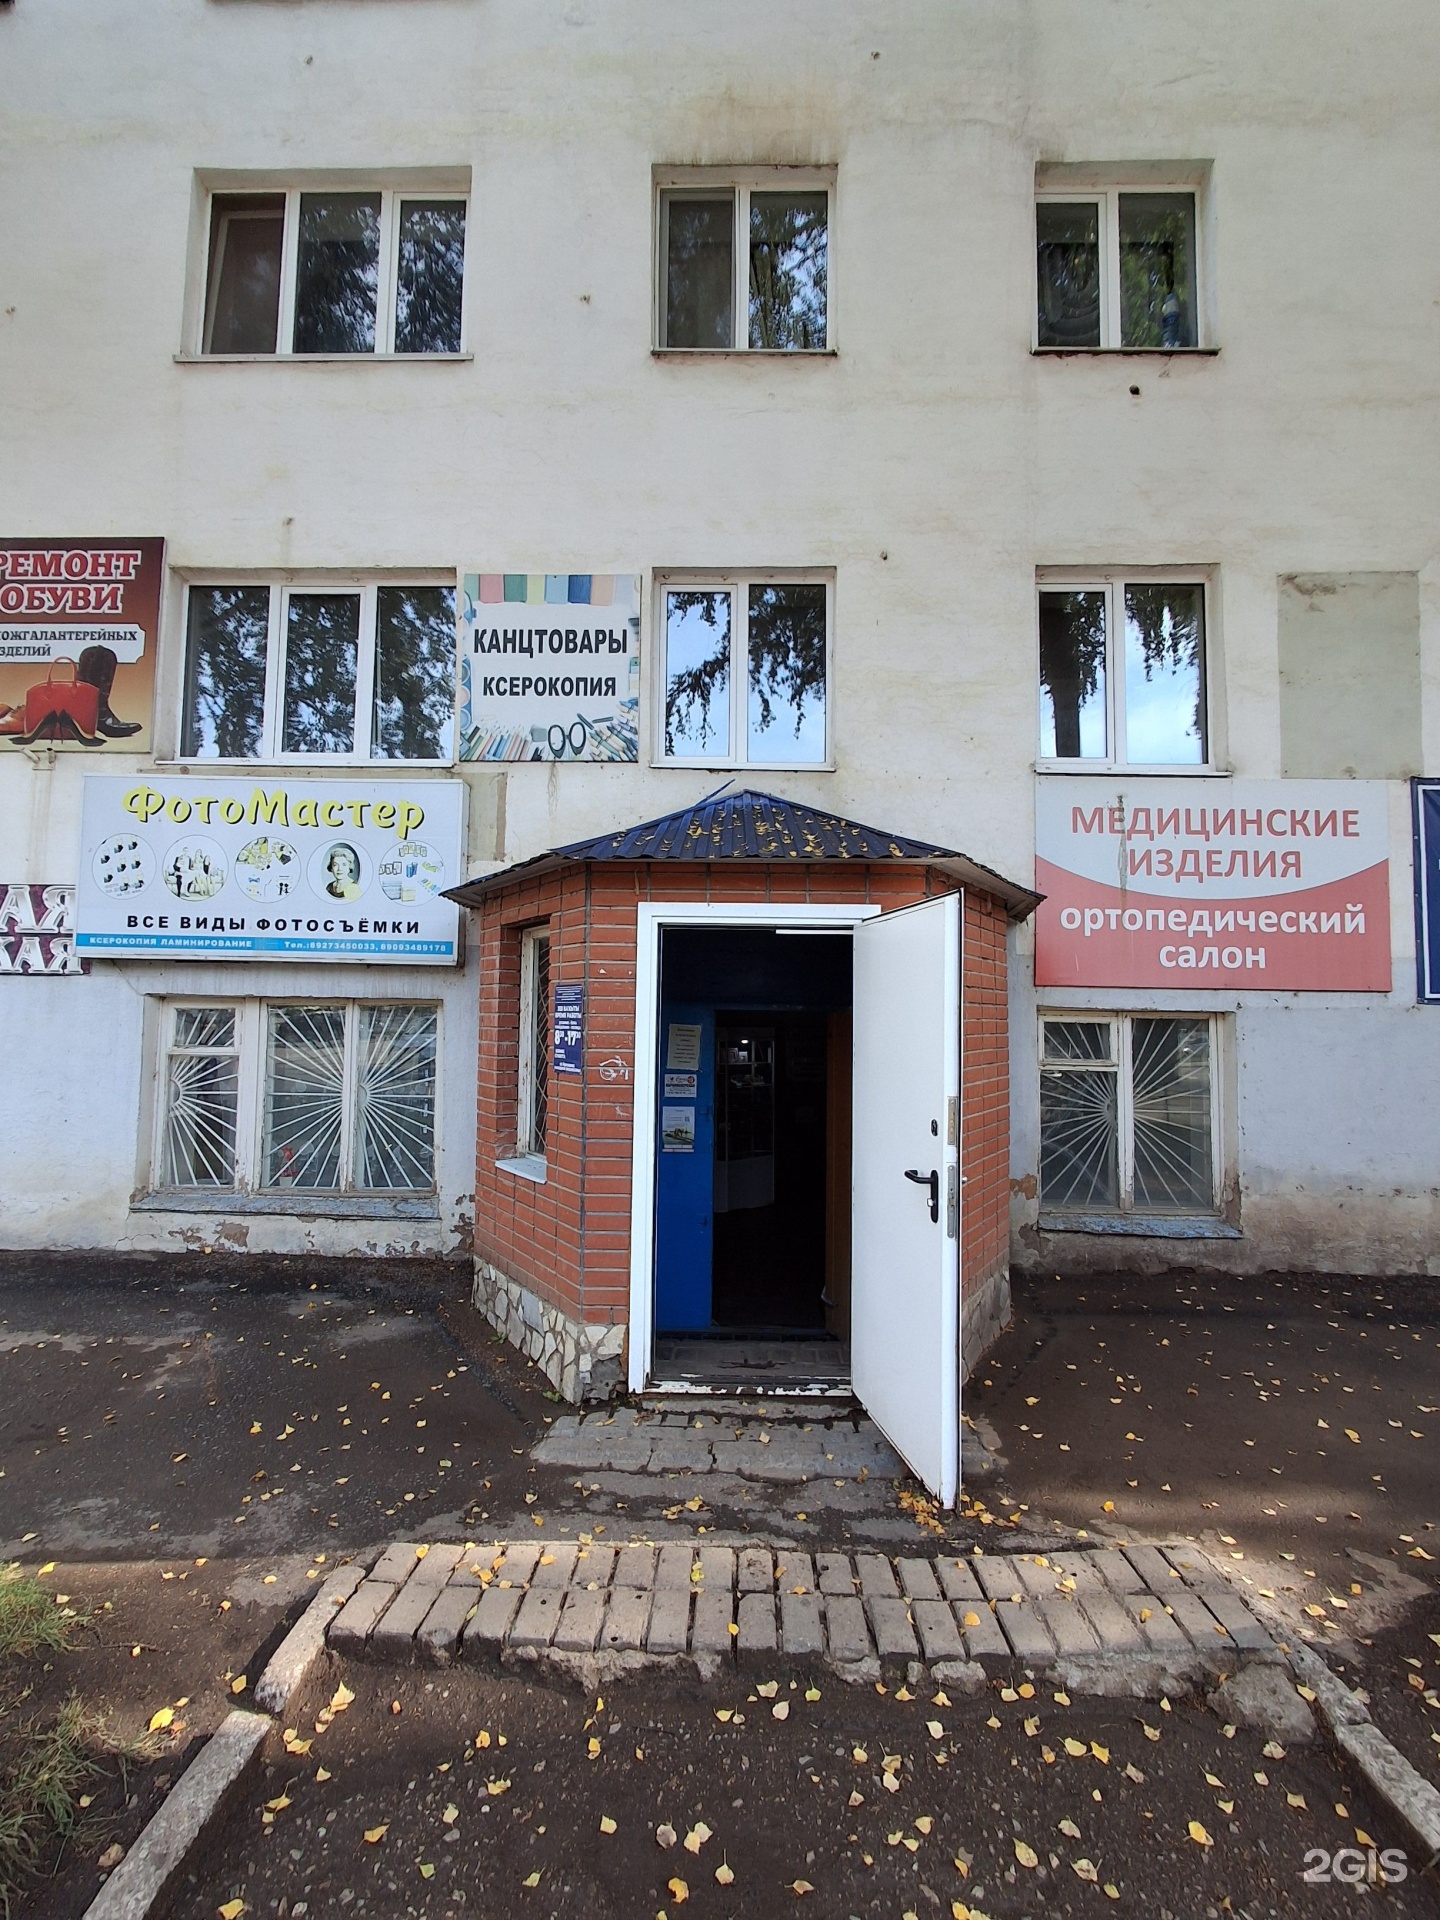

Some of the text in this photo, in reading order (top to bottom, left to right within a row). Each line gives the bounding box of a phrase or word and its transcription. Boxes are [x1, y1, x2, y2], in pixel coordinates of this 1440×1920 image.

[0, 584, 122, 613] ОБУВИ
[0, 629, 138, 641] ОЖГАЛАНТЕРЕЙНЫХ
[474, 629, 627, 658] КАНЦТОВАРЫ
[0, 644, 51, 657] ЗДЕЛИЙ
[483, 677, 616, 696] КСЕРОКОПИЯ
[122, 785, 425, 839] ФотоМастер
[1071, 806, 1360, 841] МЕДИЦИНСКИЕ
[1128, 848, 1302, 883] ИЗДЕЛИЯ
[127, 915, 419, 934] ВСЕ ВИДЫ ФОТОСЪЁМКИ
[1060, 903, 1366, 937] ортопедический
[89, 936, 157, 945] КСЕРОКОПИЯ
[160, 938, 253, 947] ЛАМИНИРОВАНИЕ
[1159, 944, 1266, 969] салон
